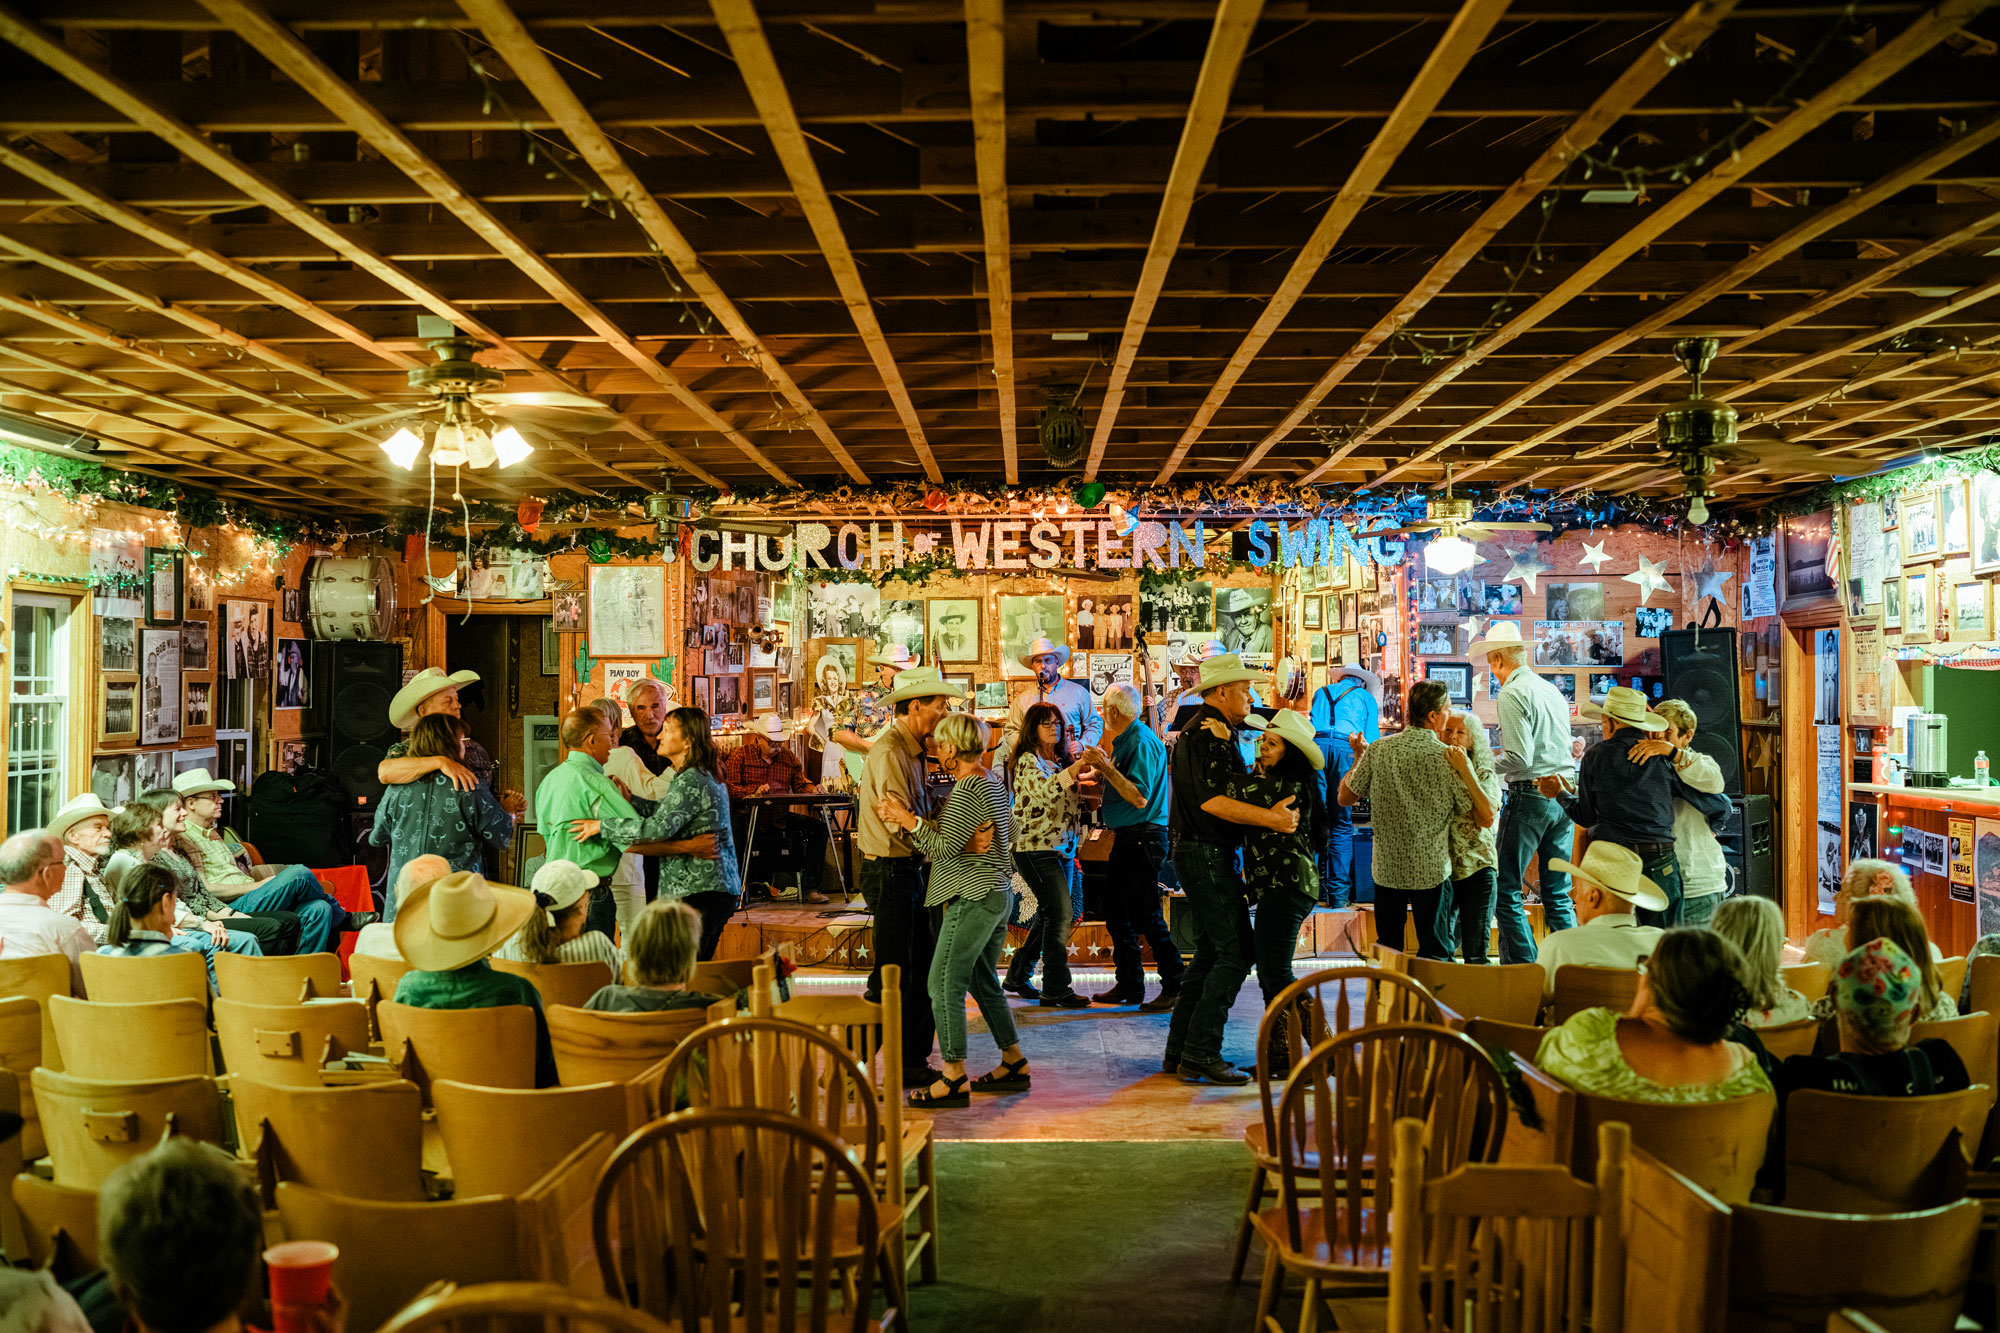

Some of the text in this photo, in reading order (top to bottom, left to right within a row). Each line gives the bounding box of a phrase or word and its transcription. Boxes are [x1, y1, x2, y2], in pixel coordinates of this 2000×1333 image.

[691, 521, 904, 571] CHURCH
[951, 519, 1205, 569] WESTERN
[1248, 517, 1405, 568] SWING
[609, 669, 640, 678] PLAY BOY
[1953, 863, 1971, 874] TEXAS
